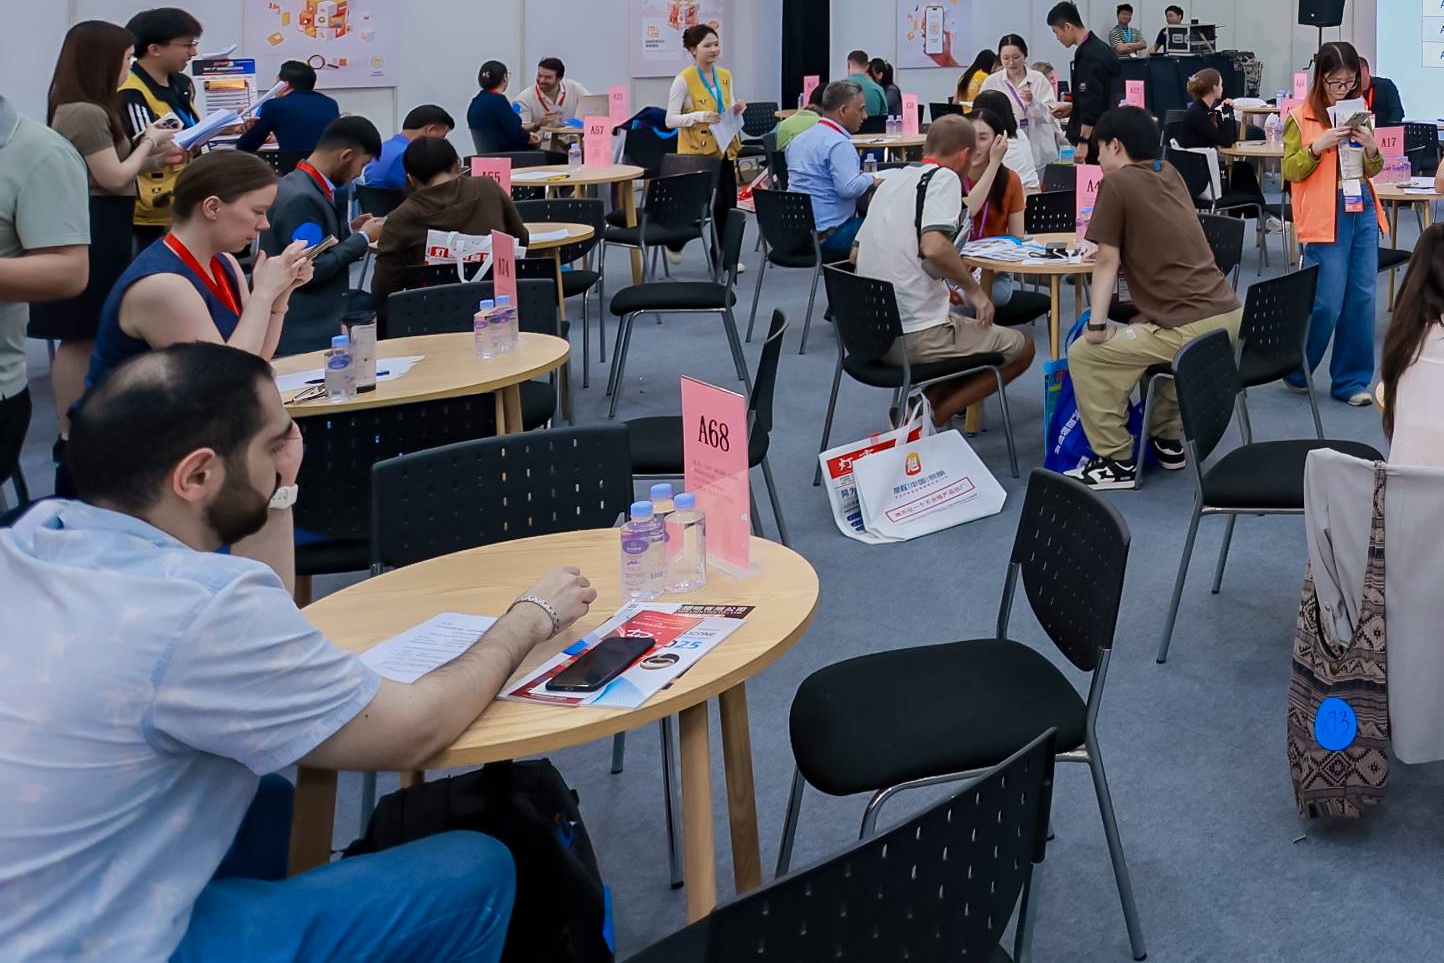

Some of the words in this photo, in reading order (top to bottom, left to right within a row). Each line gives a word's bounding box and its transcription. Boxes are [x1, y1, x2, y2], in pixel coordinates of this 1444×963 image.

[591, 125, 604, 135] A57
[1381, 137, 1396, 148] A17
[698, 415, 730, 452] A68
